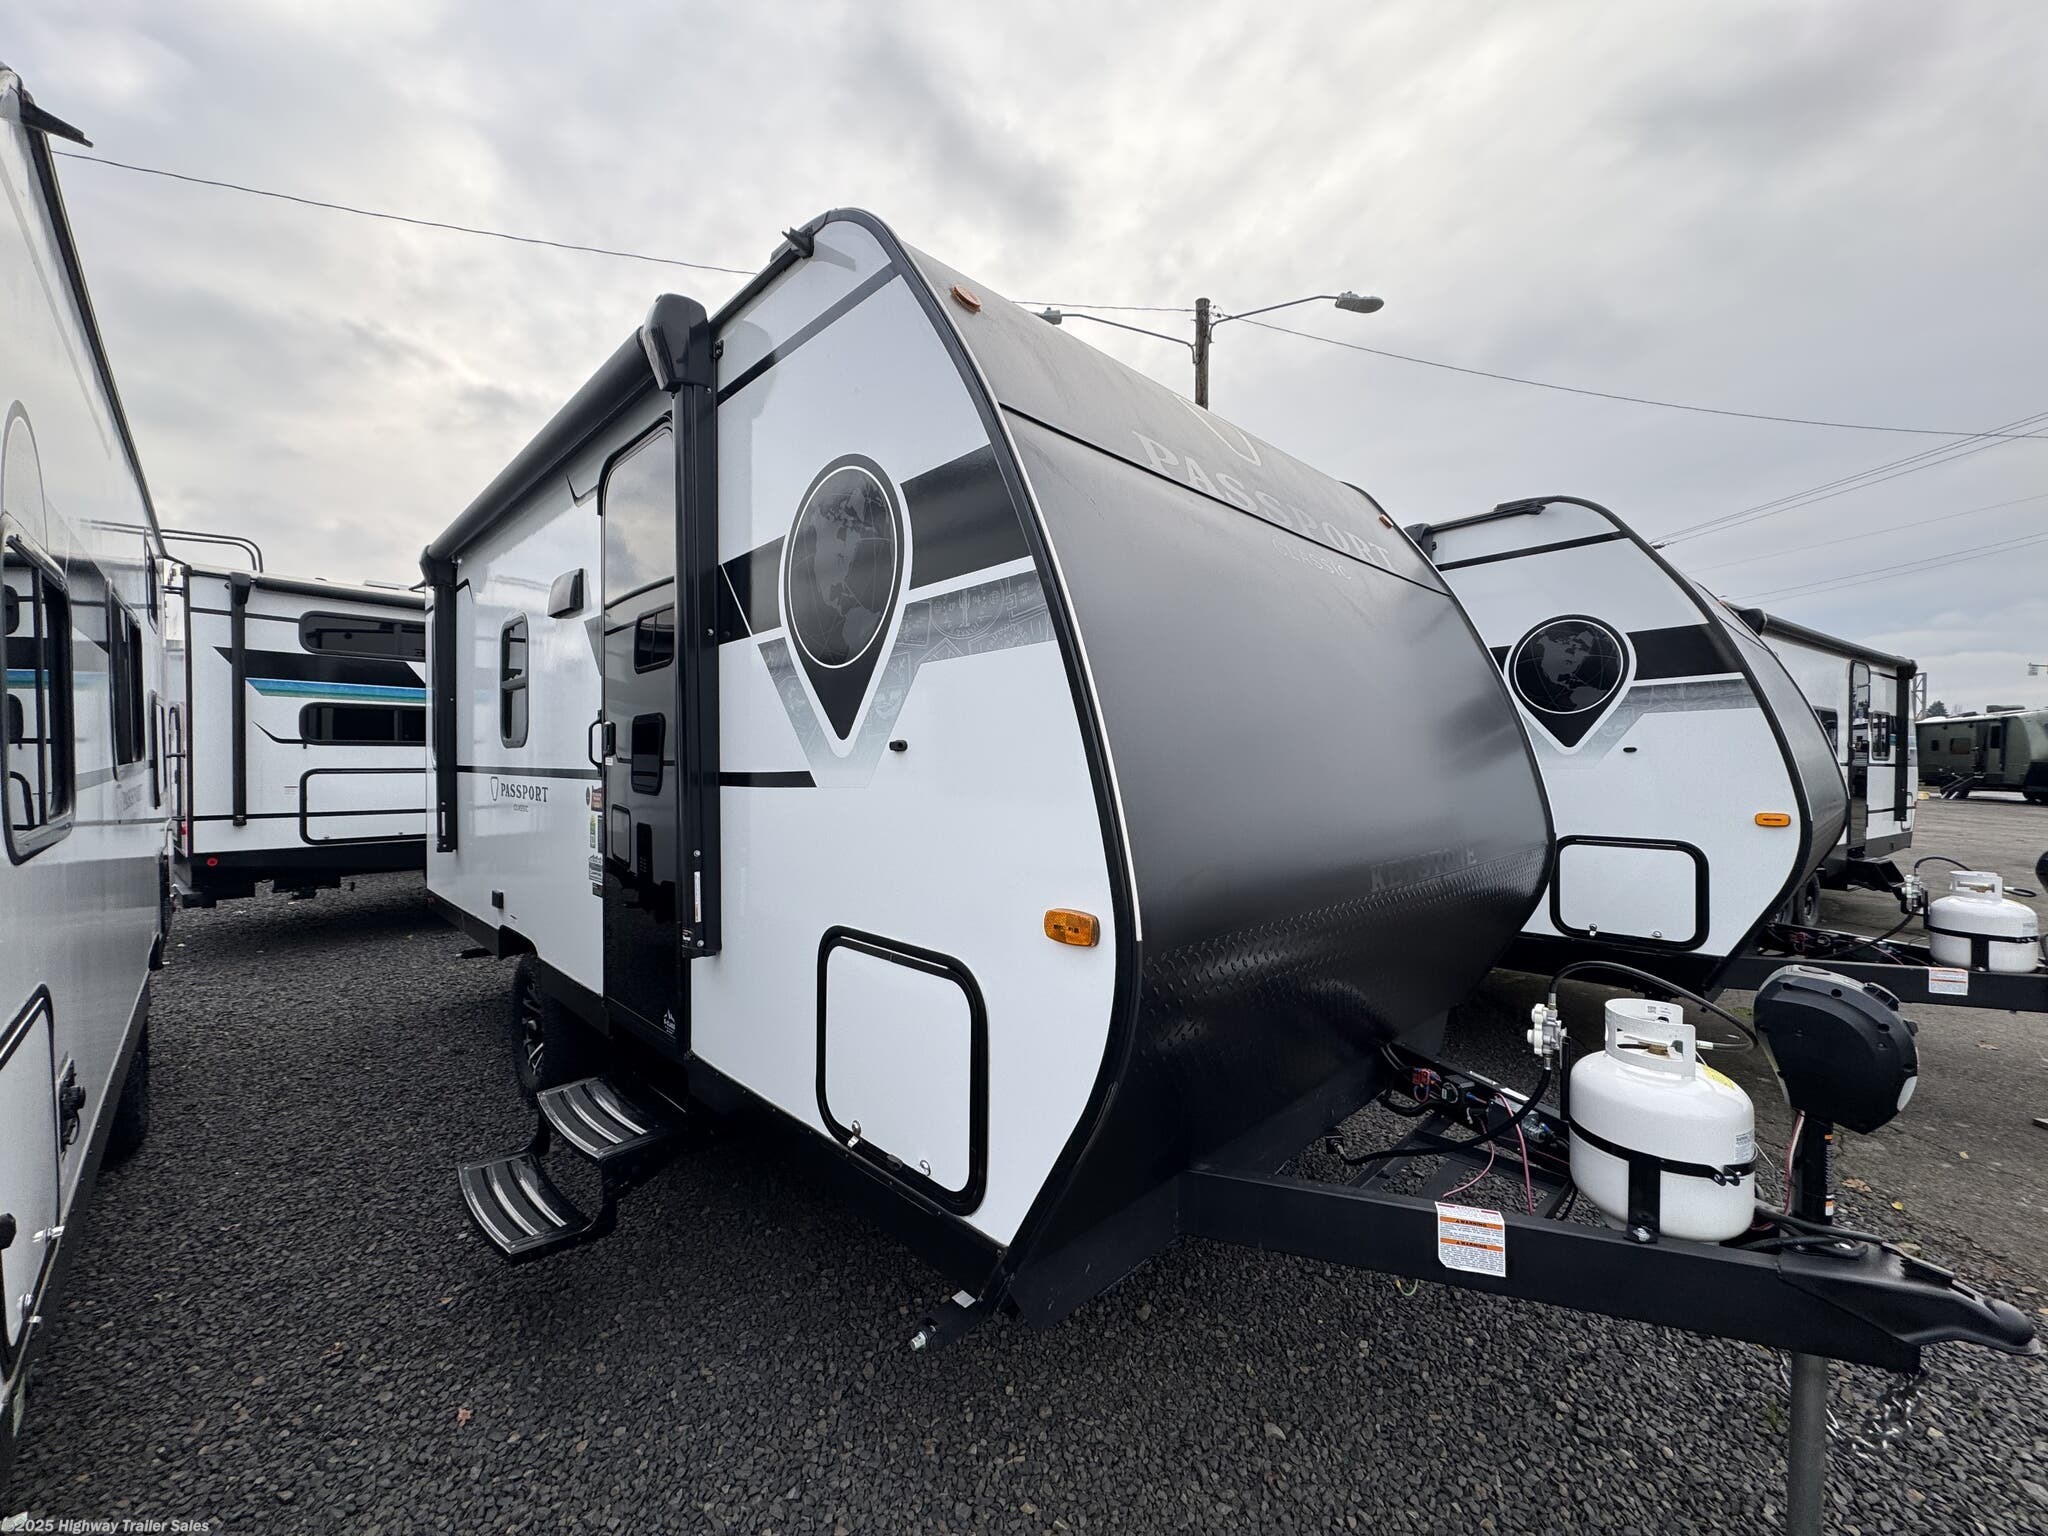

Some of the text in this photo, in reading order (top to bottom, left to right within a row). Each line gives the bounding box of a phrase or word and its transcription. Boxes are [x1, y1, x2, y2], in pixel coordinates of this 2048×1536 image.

[1132, 429, 1401, 572] PASSPORT
[500, 783, 549, 802] PASSPORT
[1461, 1219, 1487, 1228] WARNING
